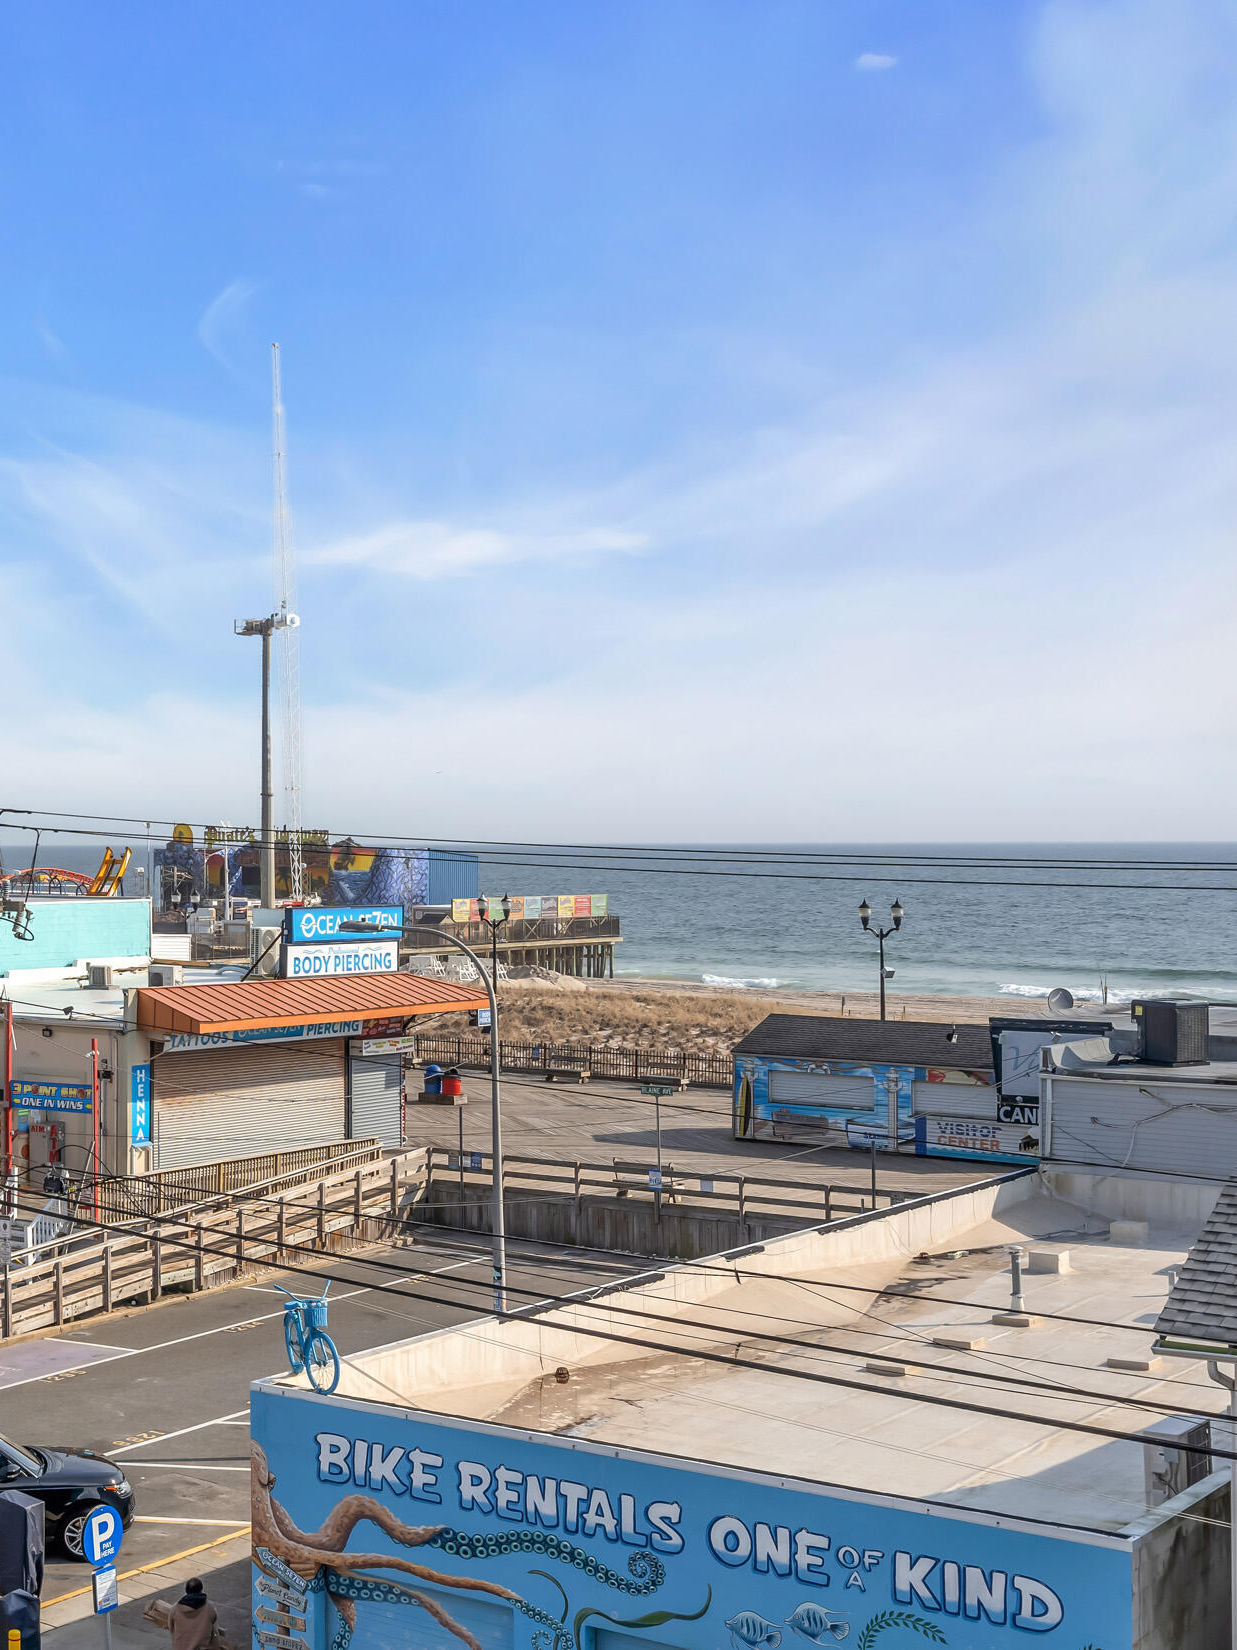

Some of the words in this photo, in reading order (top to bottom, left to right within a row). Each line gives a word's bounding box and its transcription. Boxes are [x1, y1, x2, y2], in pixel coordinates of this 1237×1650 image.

[293, 955, 331, 975] BODY
[334, 952, 392, 973] PIERCING
[171, 1031, 229, 1048] TATTOOS
[306, 1020, 360, 1036] PIERCING
[13, 1083, 22, 1095] 3
[23, 1084, 58, 1097] POINT
[60, 1087, 92, 1099] SHOT
[642, 1086, 660, 1095] BLAINE
[662, 1087, 672, 1095] AVE
[22, 1097, 42, 1107] ONE
[44, 1099, 54, 1108] IN
[56, 1100, 84, 1110] WINS
[136, 1069, 146, 1141] HENNA
[937, 1122, 1002, 1138] VISITOR
[937, 1136, 1002, 1151] CENTER
[314, 1432, 444, 1504] BIKE
[457, 1459, 686, 1554] RENTALS
[91, 1512, 115, 1561] P
[102, 1541, 113, 1550] PAY
[101, 1547, 116, 1558] HERE
[262, 1550, 285, 1570] OCEAN
[708, 1514, 832, 1588] ONE
[836, 1545, 885, 1572] OF
[846, 1570, 866, 1592] A
[893, 1550, 1065, 1633] KIND
[261, 1583, 282, 1596] Planet
[282, 1589, 302, 1606] Candy
